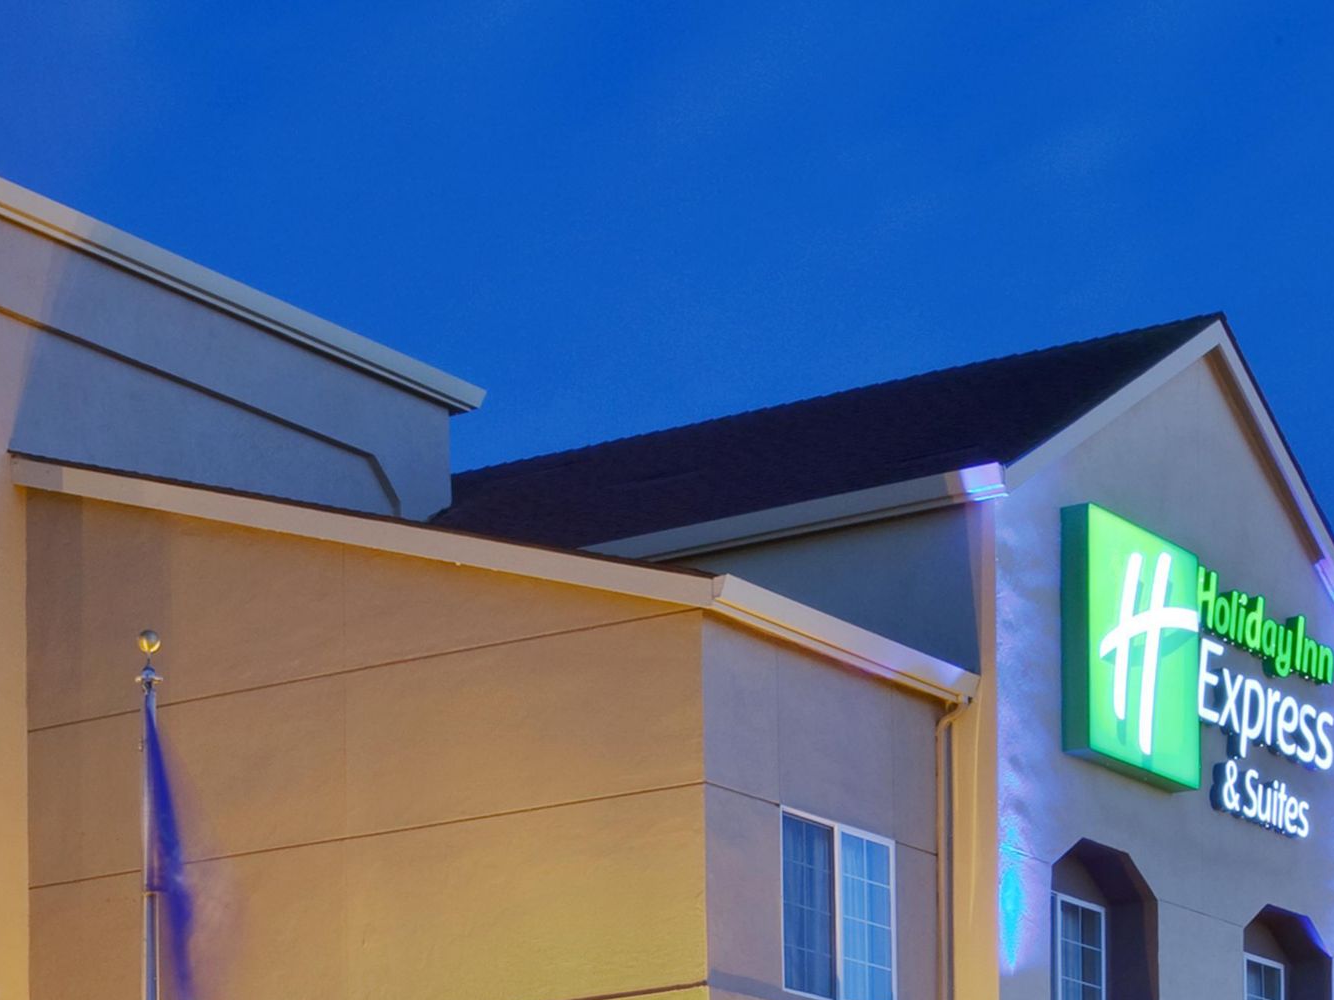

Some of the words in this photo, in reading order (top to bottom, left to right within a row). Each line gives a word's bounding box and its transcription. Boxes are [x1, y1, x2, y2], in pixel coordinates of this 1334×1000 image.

[1197, 566, 1293, 677] Holiday
[1295, 615, 1333, 684] Inn
[1197, 637, 1334, 770] Express
[1222, 760, 1240, 811] &
[1243, 769, 1310, 838] Suites
